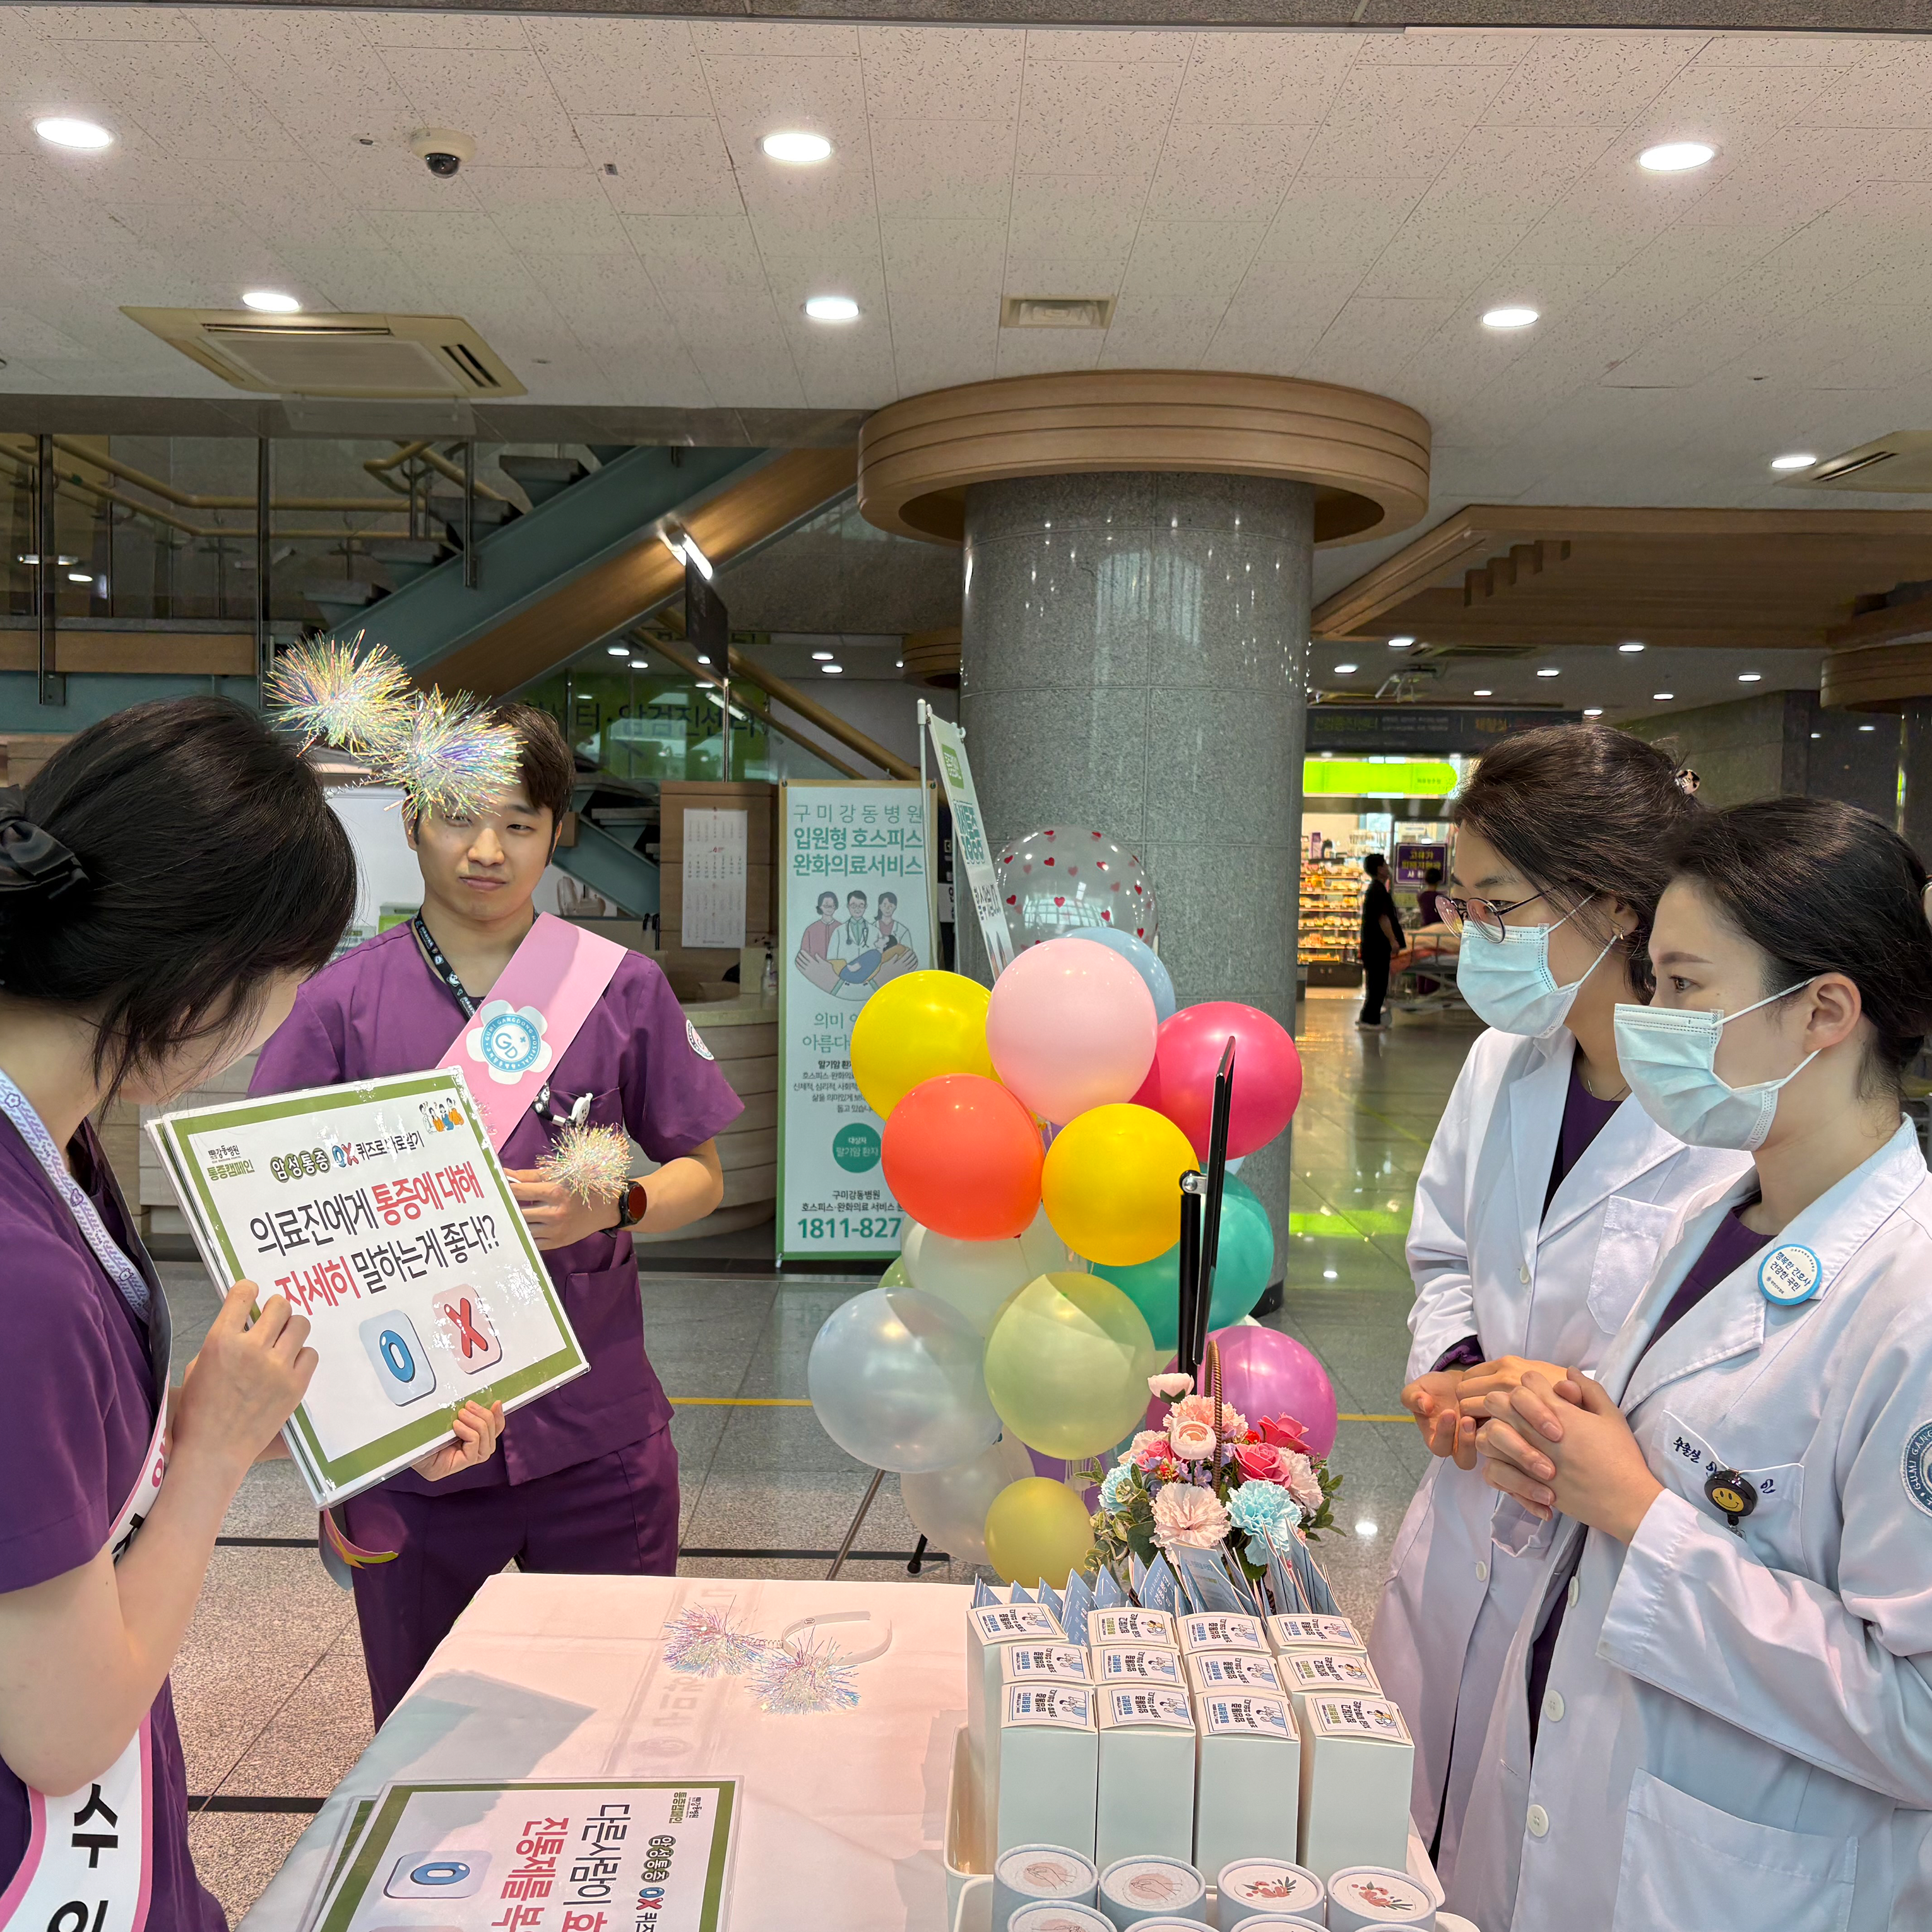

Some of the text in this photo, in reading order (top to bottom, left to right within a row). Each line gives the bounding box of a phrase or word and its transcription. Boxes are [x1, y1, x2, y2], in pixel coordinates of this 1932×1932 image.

[794, 804, 922, 824] 구미강동병원
[794, 827, 923, 851] 입원형 호스피스
[793, 854, 923, 877] 완화의료서비스
[485, 1023, 496, 1041] GUMI
[497, 1017, 533, 1034] GANGDONG
[814, 1012, 843, 1029] 의미
[818, 1060, 840, 1070] 말기암
[862, 1147, 879, 1157] 환자
[207, 1159, 256, 1181] 통증캠페인
[271, 1149, 329, 1182] 암성통증
[832, 1190, 880, 1200] 구미강동병원
[871, 1202, 894, 1212] 서비스
[249, 1161, 485, 1257] 의료진에게 통증에 대해
[798, 1218, 902, 1238] 1811-827
[273, 1254, 361, 1316] 자세히
[350, 1228, 449, 1295] 말하는게
[1770, 1262, 1789, 1280] 건강한
[1787, 1277, 1801, 1291] 국민
[1775, 1252, 1794, 1270] 행복한
[1792, 1267, 1811, 1286] 간호사
[1907, 1460, 1921, 1490] GUMI
[668, 1792, 687, 1823] 통증캠페인
[563, 1803, 631, 1905] 다른사람이
[642, 1835, 675, 1882] 암성통증
[490, 1817, 569, 1932] 진통제를 복
[636, 1887, 665, 1911] OX
